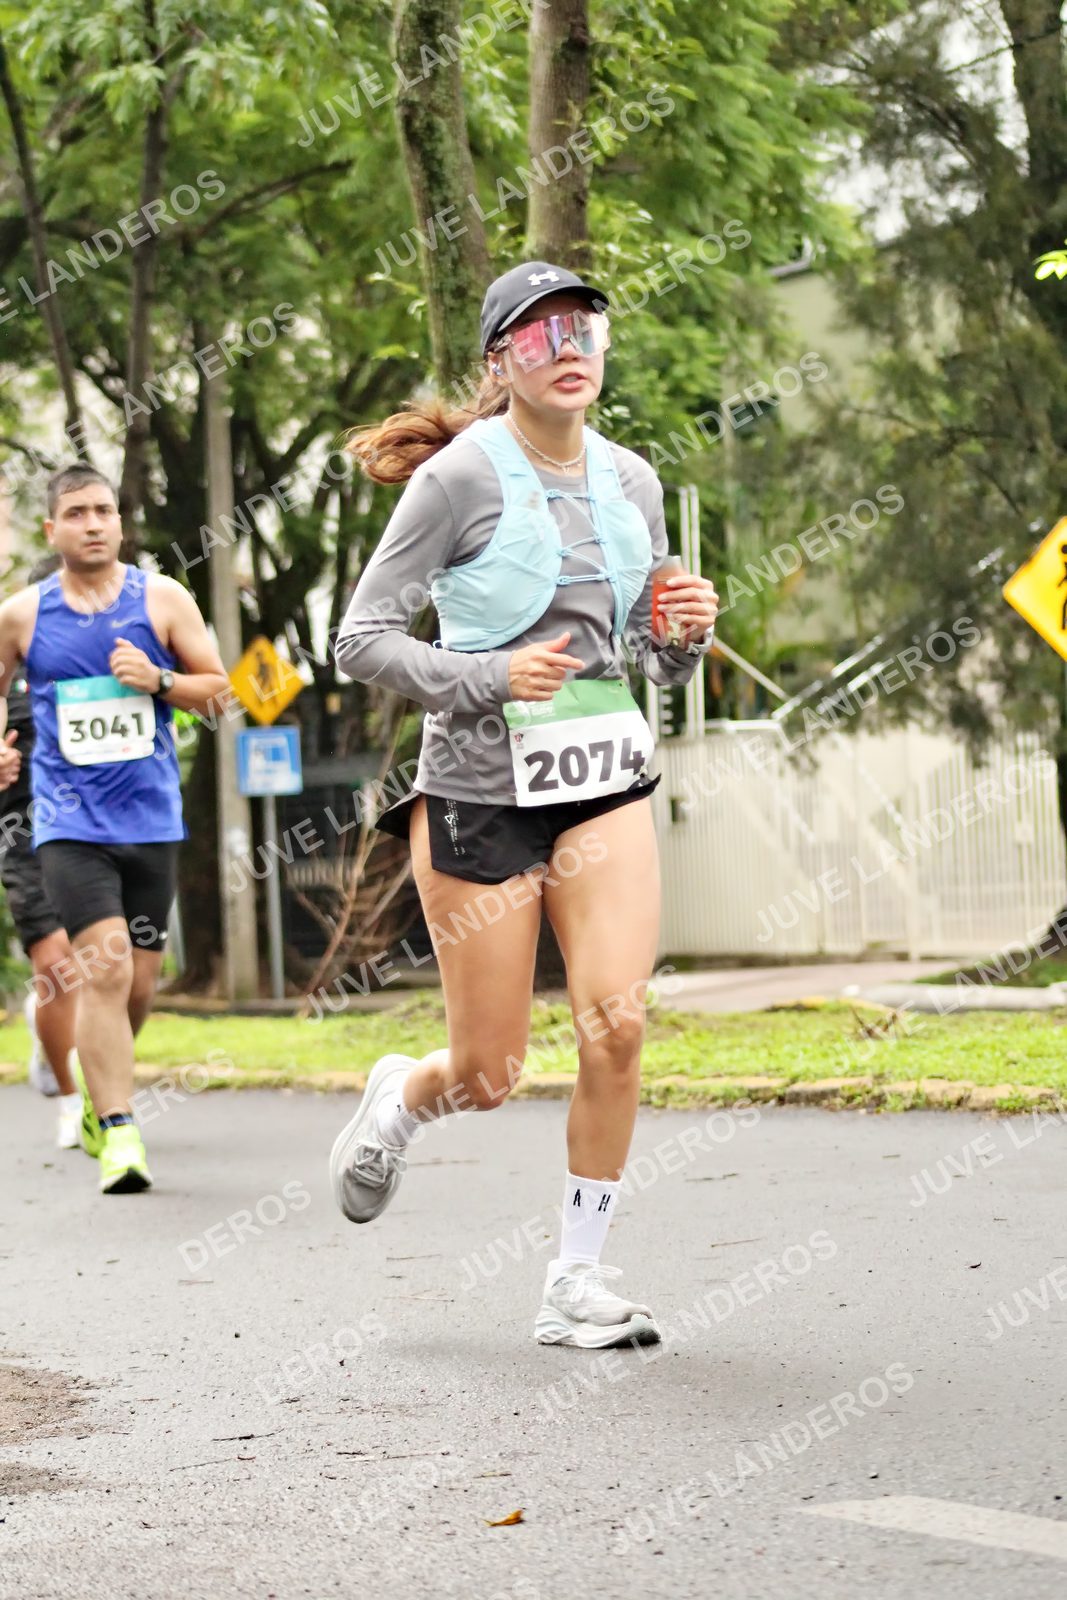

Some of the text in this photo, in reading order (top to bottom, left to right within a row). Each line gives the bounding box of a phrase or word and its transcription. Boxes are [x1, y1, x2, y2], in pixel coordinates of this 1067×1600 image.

[69, 712, 145, 743] 3041
[524, 737, 646, 792] 2074
[598, 1194, 611, 1212] H
